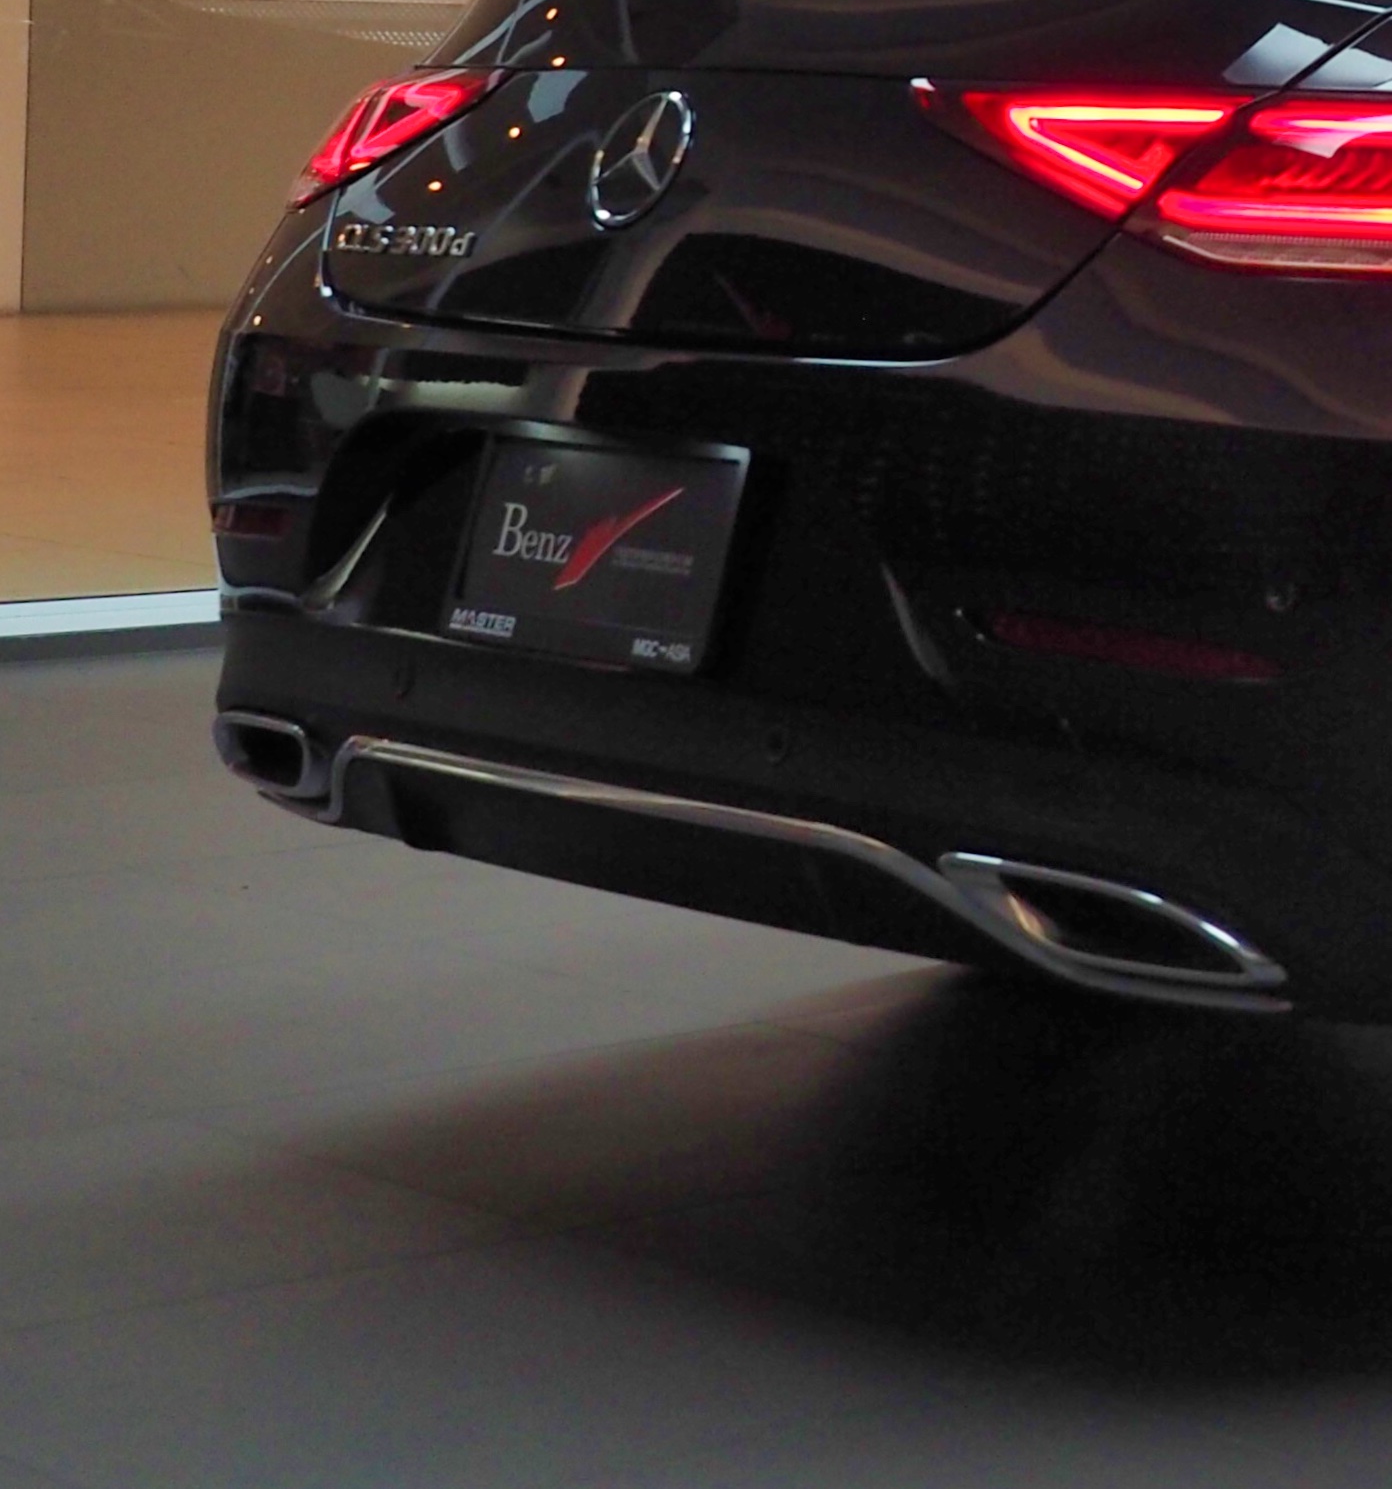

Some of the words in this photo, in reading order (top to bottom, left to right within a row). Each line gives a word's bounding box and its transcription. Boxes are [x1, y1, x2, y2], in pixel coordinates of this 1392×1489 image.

[337, 223, 393, 253] CLS
[492, 502, 573, 564] Benz
[451, 608, 516, 633] MASTER
